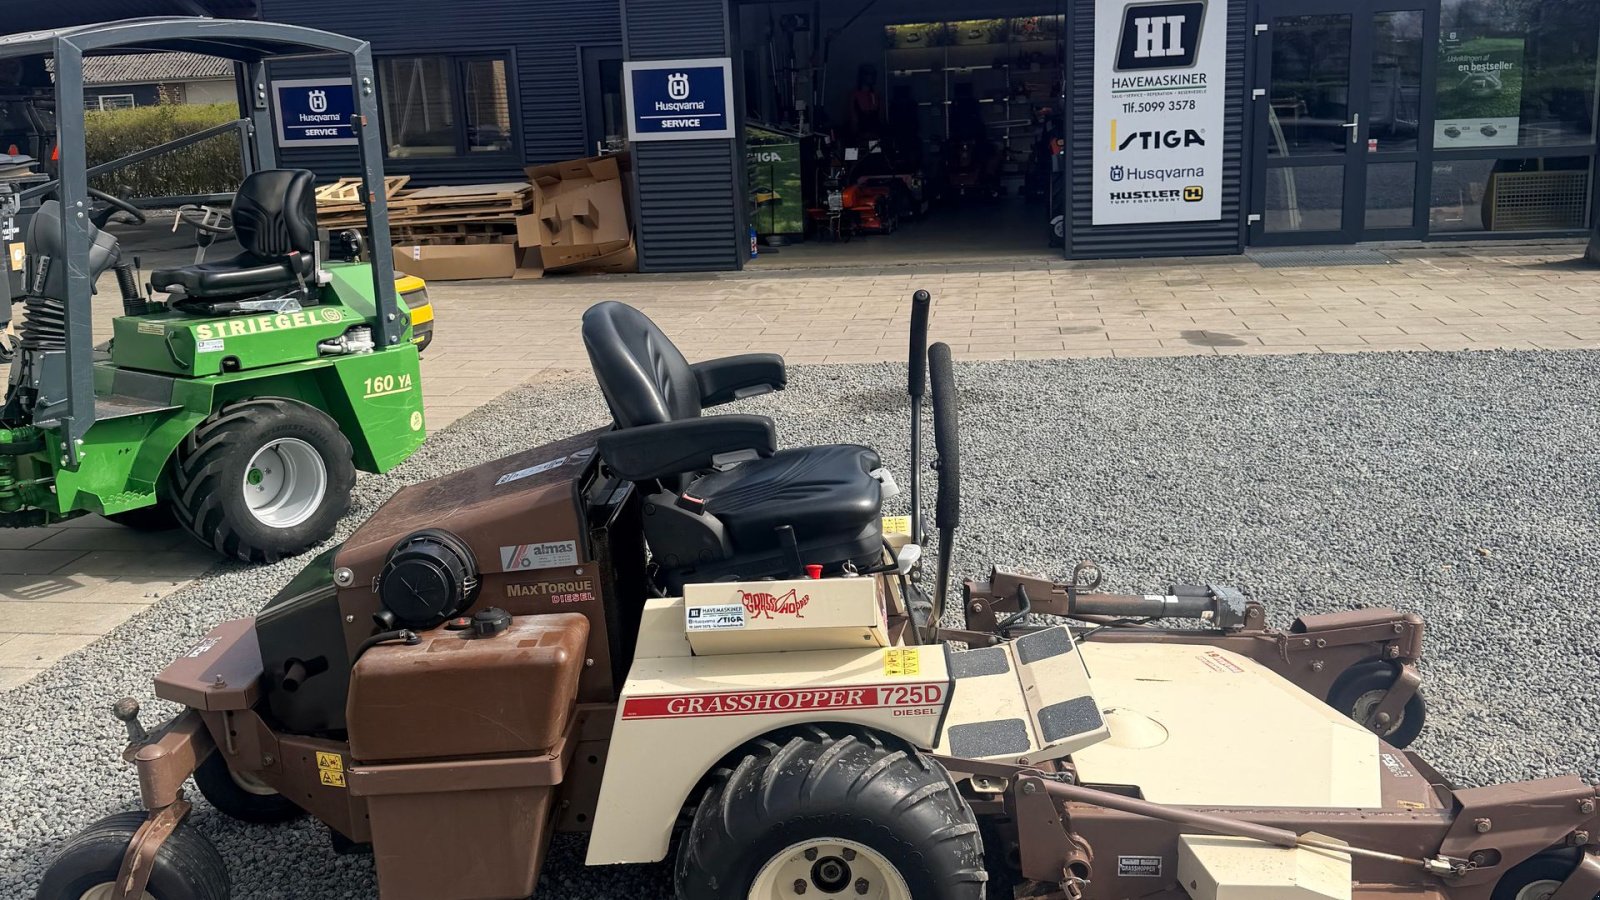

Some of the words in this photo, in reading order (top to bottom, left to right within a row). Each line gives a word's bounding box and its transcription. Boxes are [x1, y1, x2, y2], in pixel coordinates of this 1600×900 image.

[1134, 15, 1185, 58] HI
[1471, 61, 1514, 71] bestseller
[1112, 73, 1207, 88] HAVEMASKINER
[655, 101, 705, 112] Husqvarna
[1168, 100, 1196, 111] 3578
[299, 114, 340, 122] Husqvarna
[661, 118, 701, 128] SERVICE
[305, 128, 338, 136] SERVICE
[1118, 129, 1206, 151] STIGA
[1127, 166, 1205, 182] Husqvarna
[1110, 189, 1180, 200] HUSTLER
[196, 311, 322, 340] STRIEGEL
[364, 374, 394, 394] 160
[398, 373, 412, 388] YA
[533, 543, 574, 556] almas
[551, 592, 595, 603] DIESEL
[717, 616, 744, 624] STIGA
[667, 688, 864, 714] GRASSHOPPER
[880, 685, 942, 705] 725D
[893, 708, 937, 717] DIESEL
